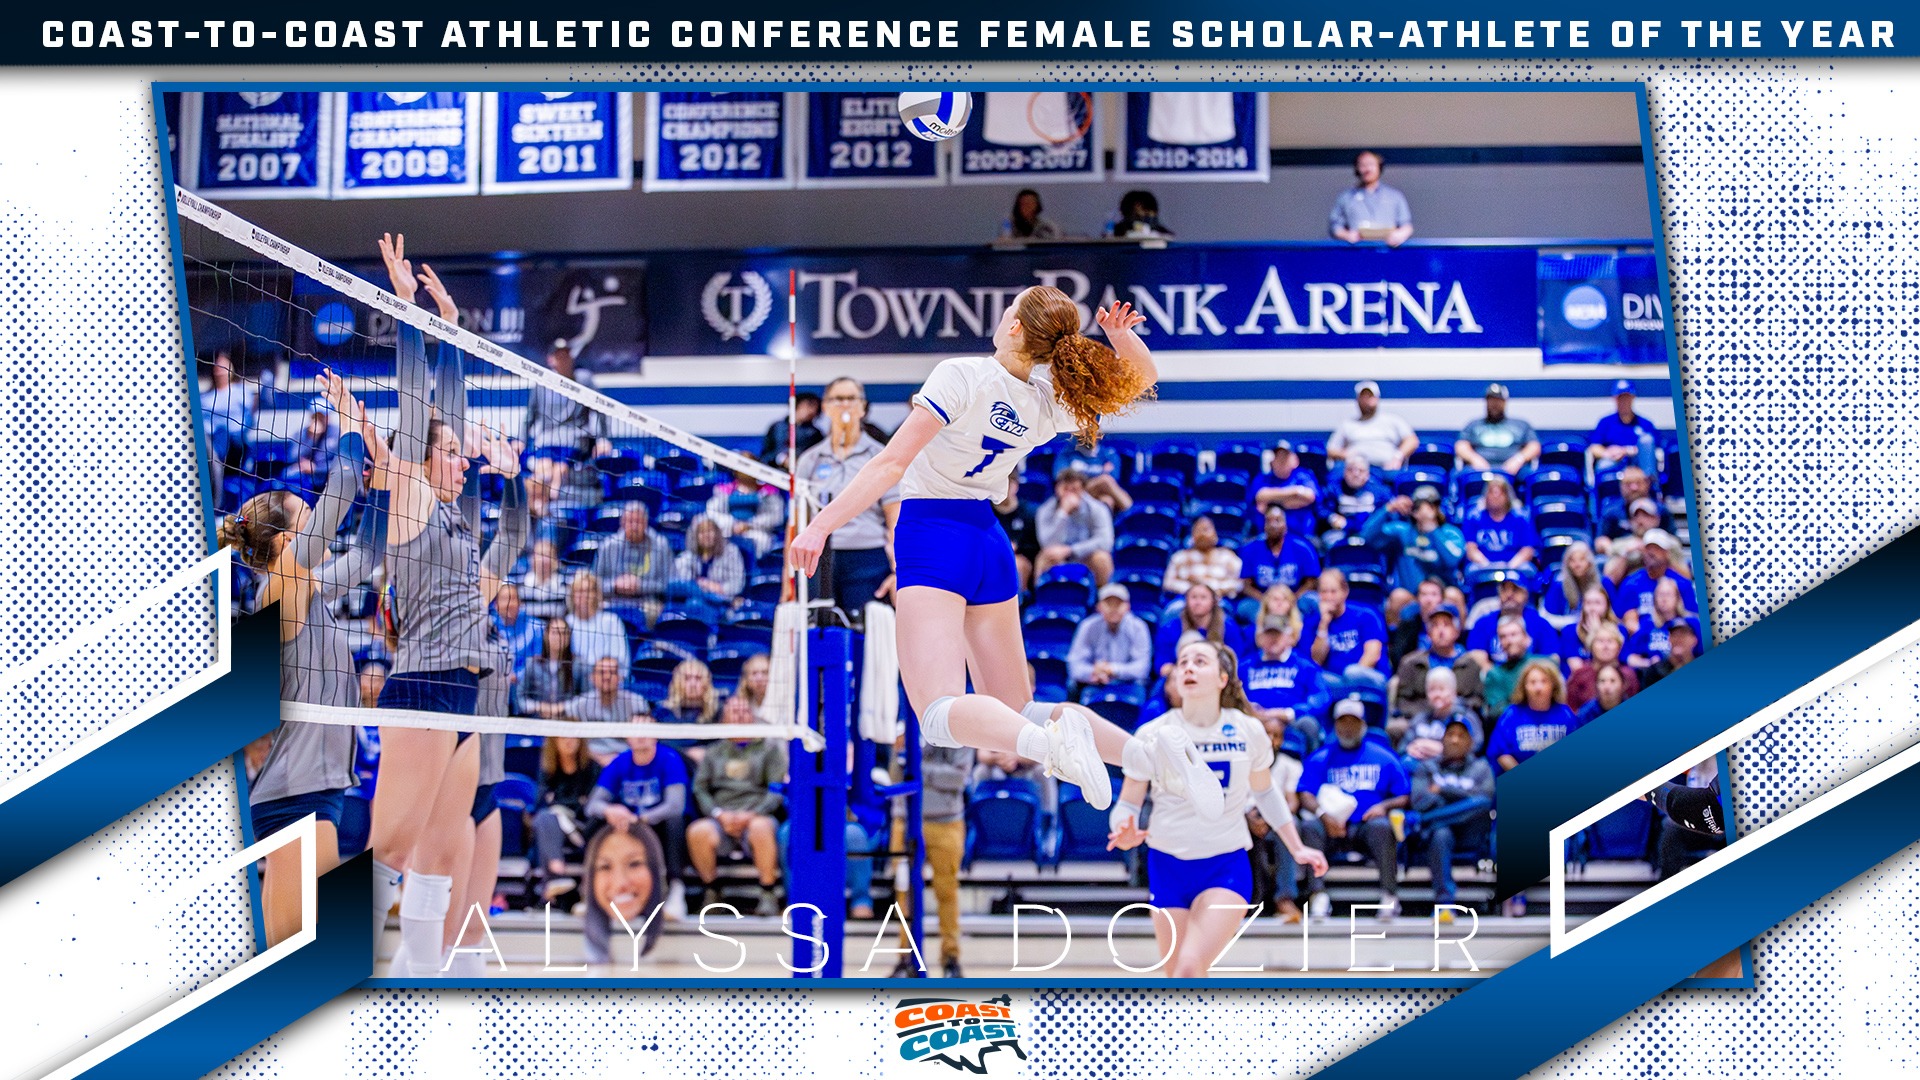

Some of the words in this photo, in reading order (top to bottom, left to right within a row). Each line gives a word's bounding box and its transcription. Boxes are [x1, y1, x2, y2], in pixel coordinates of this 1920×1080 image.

[518, 101, 598, 123] SWEET
[218, 132, 300, 150] FINALIST
[511, 120, 604, 144] SIXTEEN
[217, 152, 301, 182] 2007
[361, 149, 449, 180] 2009
[518, 144, 598, 175] 2011
[679, 142, 763, 172] 2012
[830, 141, 913, 169] 2012
[1235, 264, 1484, 335] ARENA
[962, 434, 1017, 479] 7
